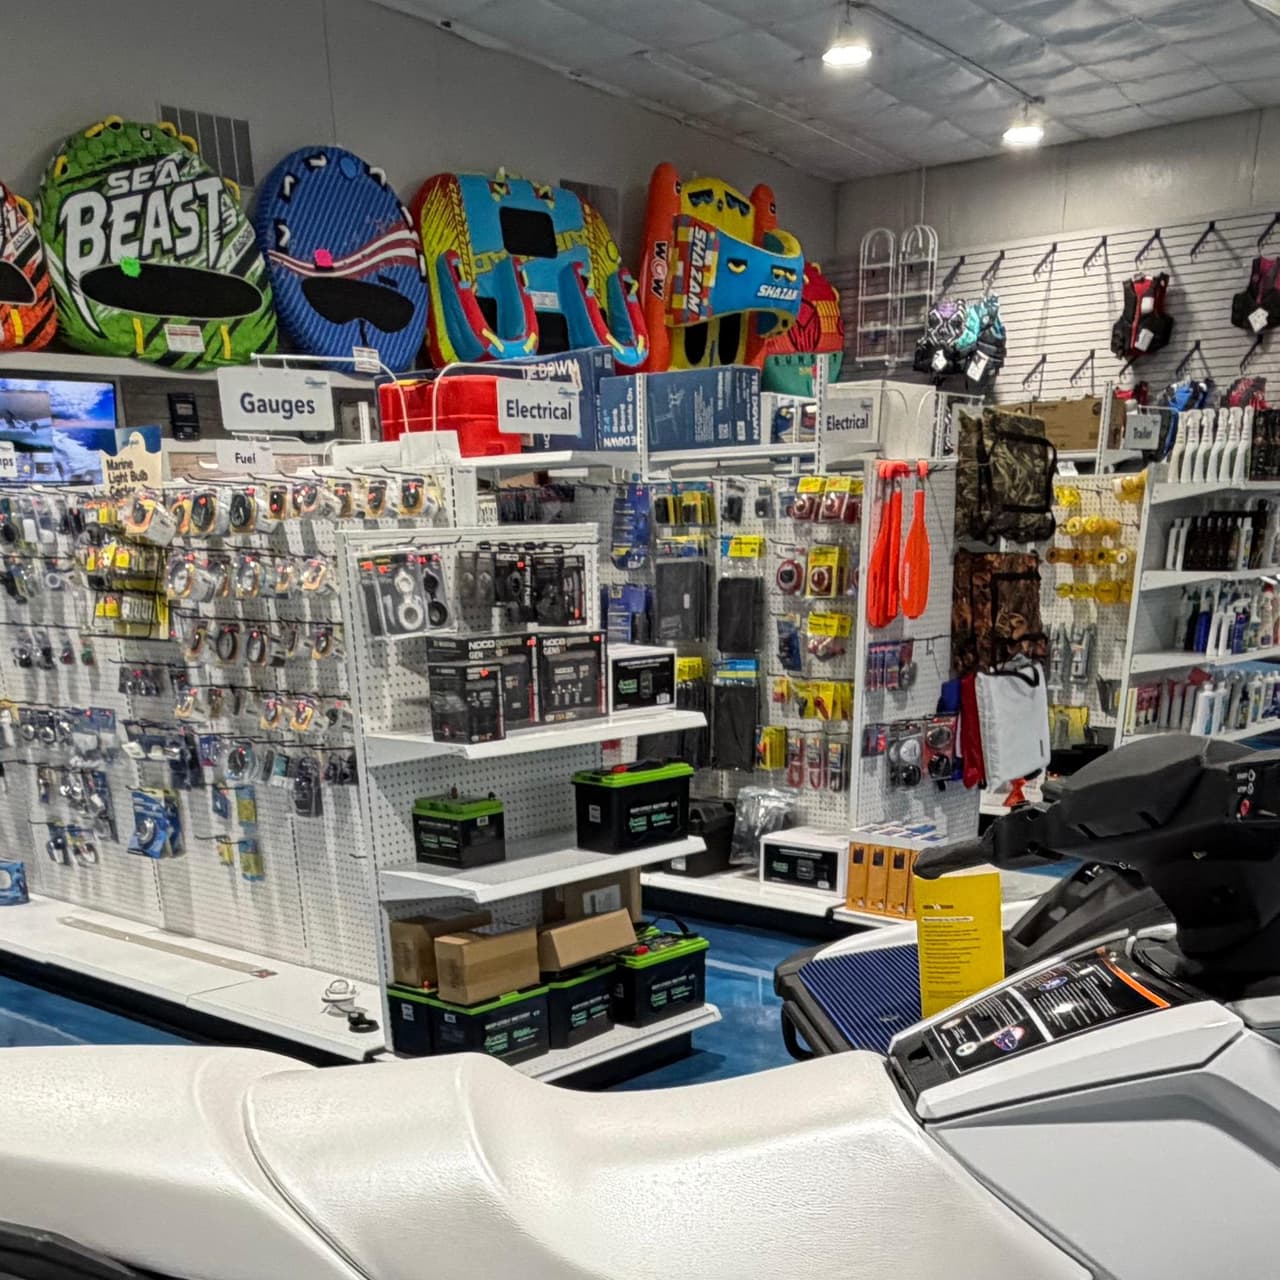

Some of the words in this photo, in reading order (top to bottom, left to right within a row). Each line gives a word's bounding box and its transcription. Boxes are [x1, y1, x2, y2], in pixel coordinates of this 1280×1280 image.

[107, 160, 181, 197] SEA
[59, 177, 223, 272] BEAST
[650, 240, 668, 300] WOW
[685, 225, 708, 318] SHAZAM
[239, 392, 316, 420] Gauges
[506, 398, 572, 420] Electrical
[826, 412, 869, 432] Electrical
[106, 459, 134, 471] Marine
[234, 451, 257, 465] Fuel
[108, 471, 128, 485] Light
[130, 469, 149, 482] Bulb
[468, 639, 495, 650] NOCO
